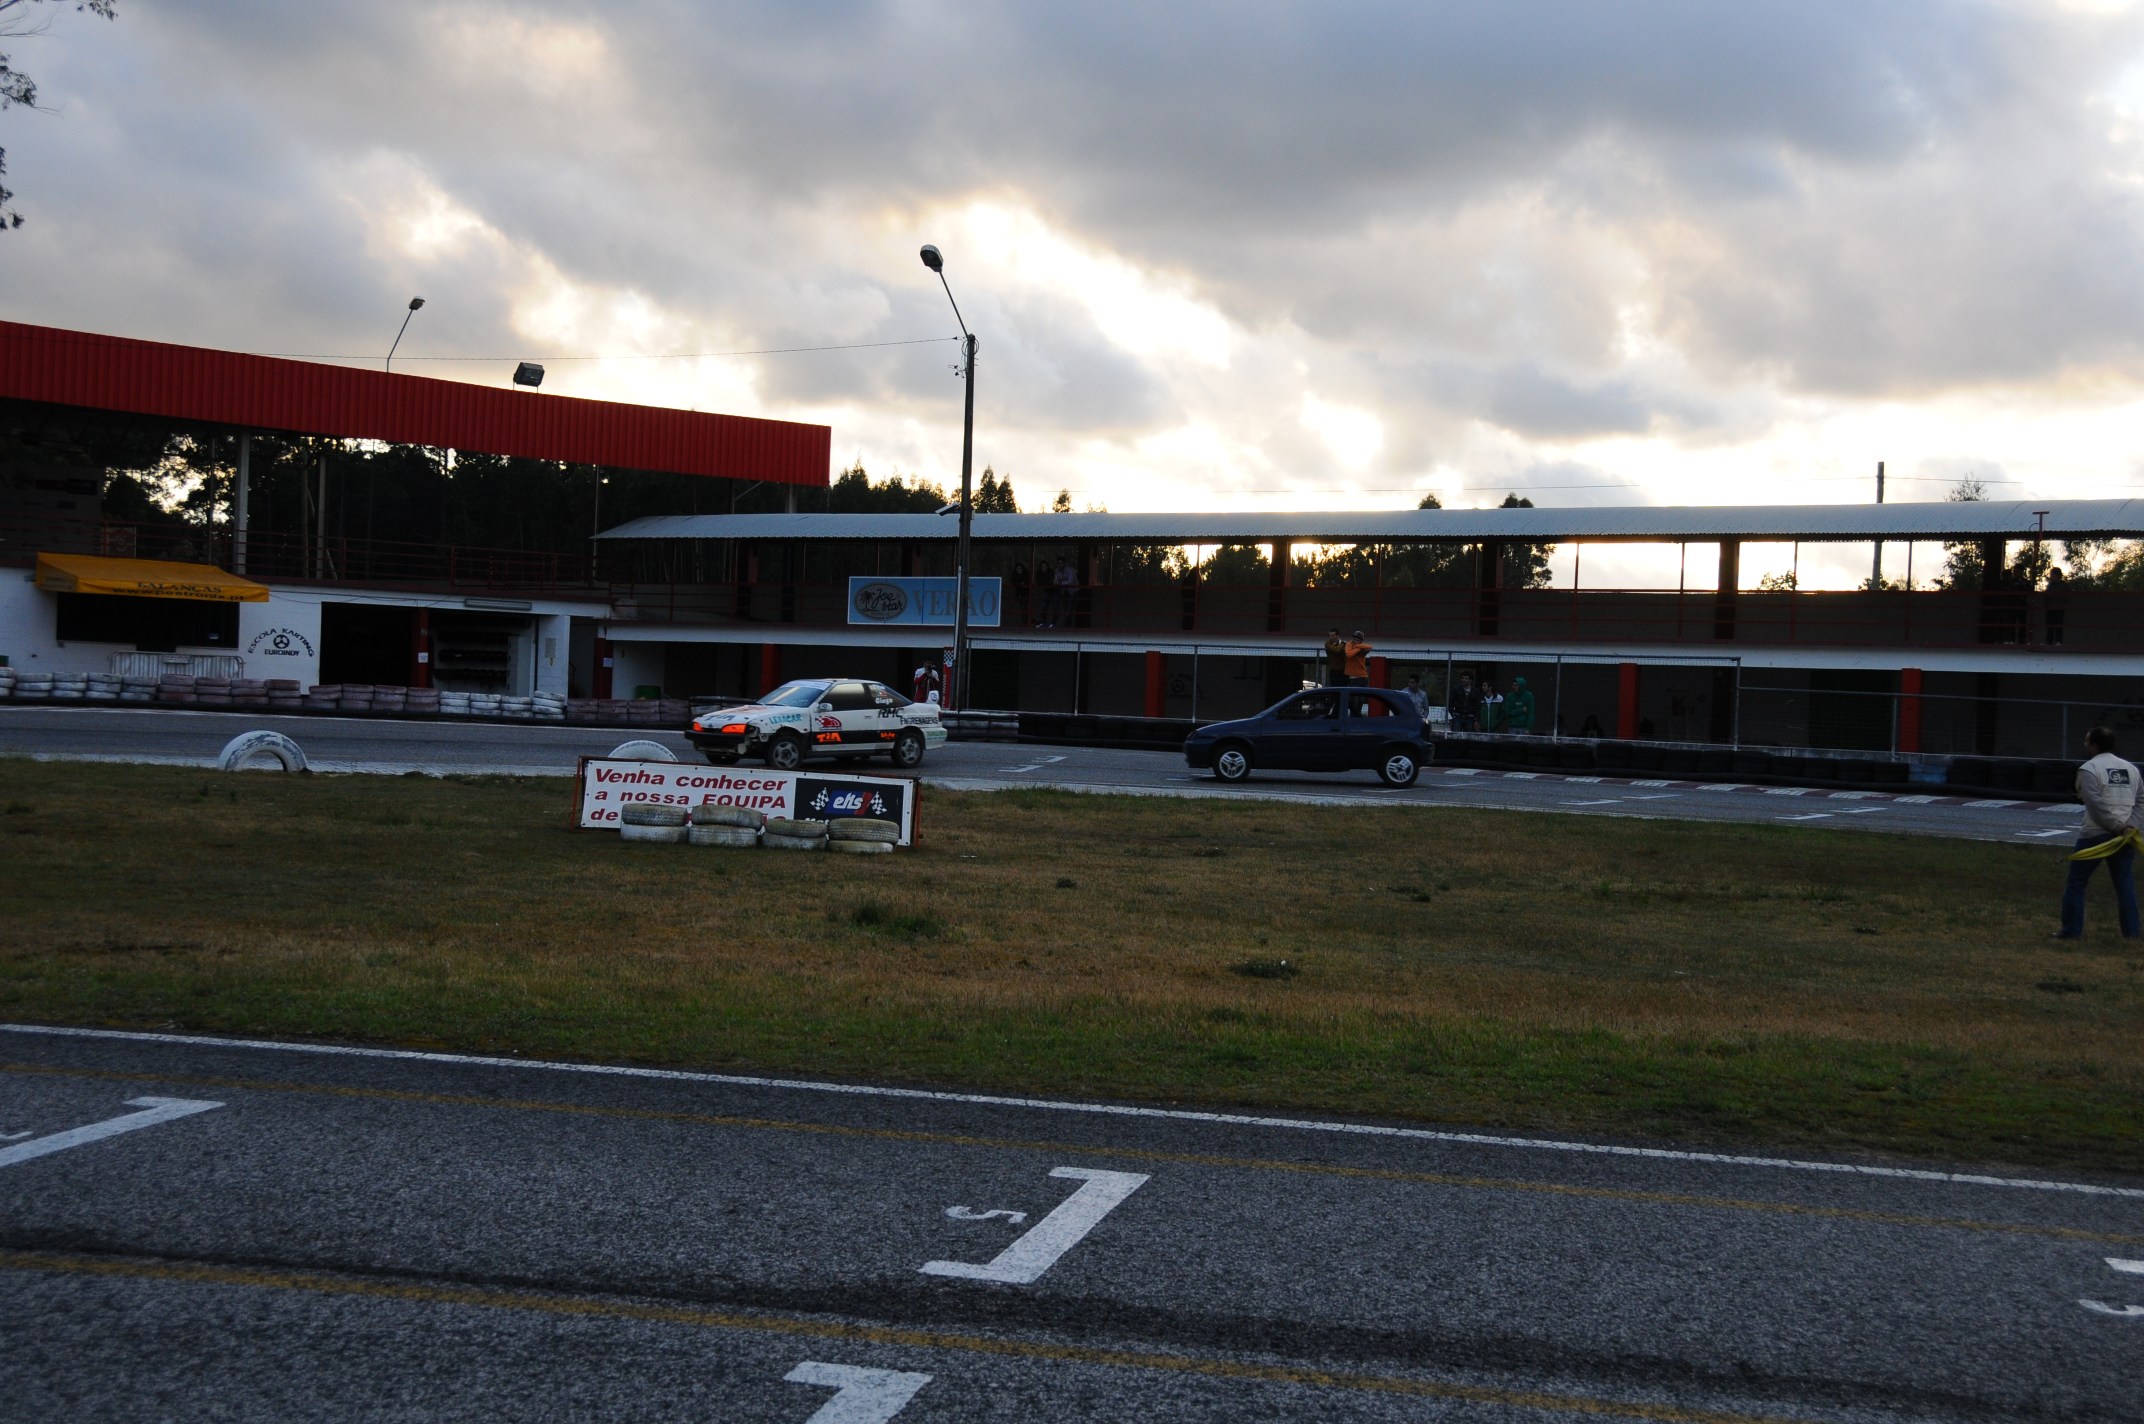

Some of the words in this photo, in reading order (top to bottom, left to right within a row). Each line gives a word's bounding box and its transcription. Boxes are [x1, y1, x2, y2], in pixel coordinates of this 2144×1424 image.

[248, 628, 277, 654] ESCOLA
[282, 628, 315, 657] KARTING
[264, 649, 300, 657] EUROINDY
[877, 708, 905, 719] RMC
[595, 768, 665, 785] Venha
[675, 775, 788, 791] conhecer
[594, 791, 608, 801] a
[620, 792, 690, 805] nossa
[702, 794, 786, 809] EQUIPA
[590, 808, 619, 821] de
